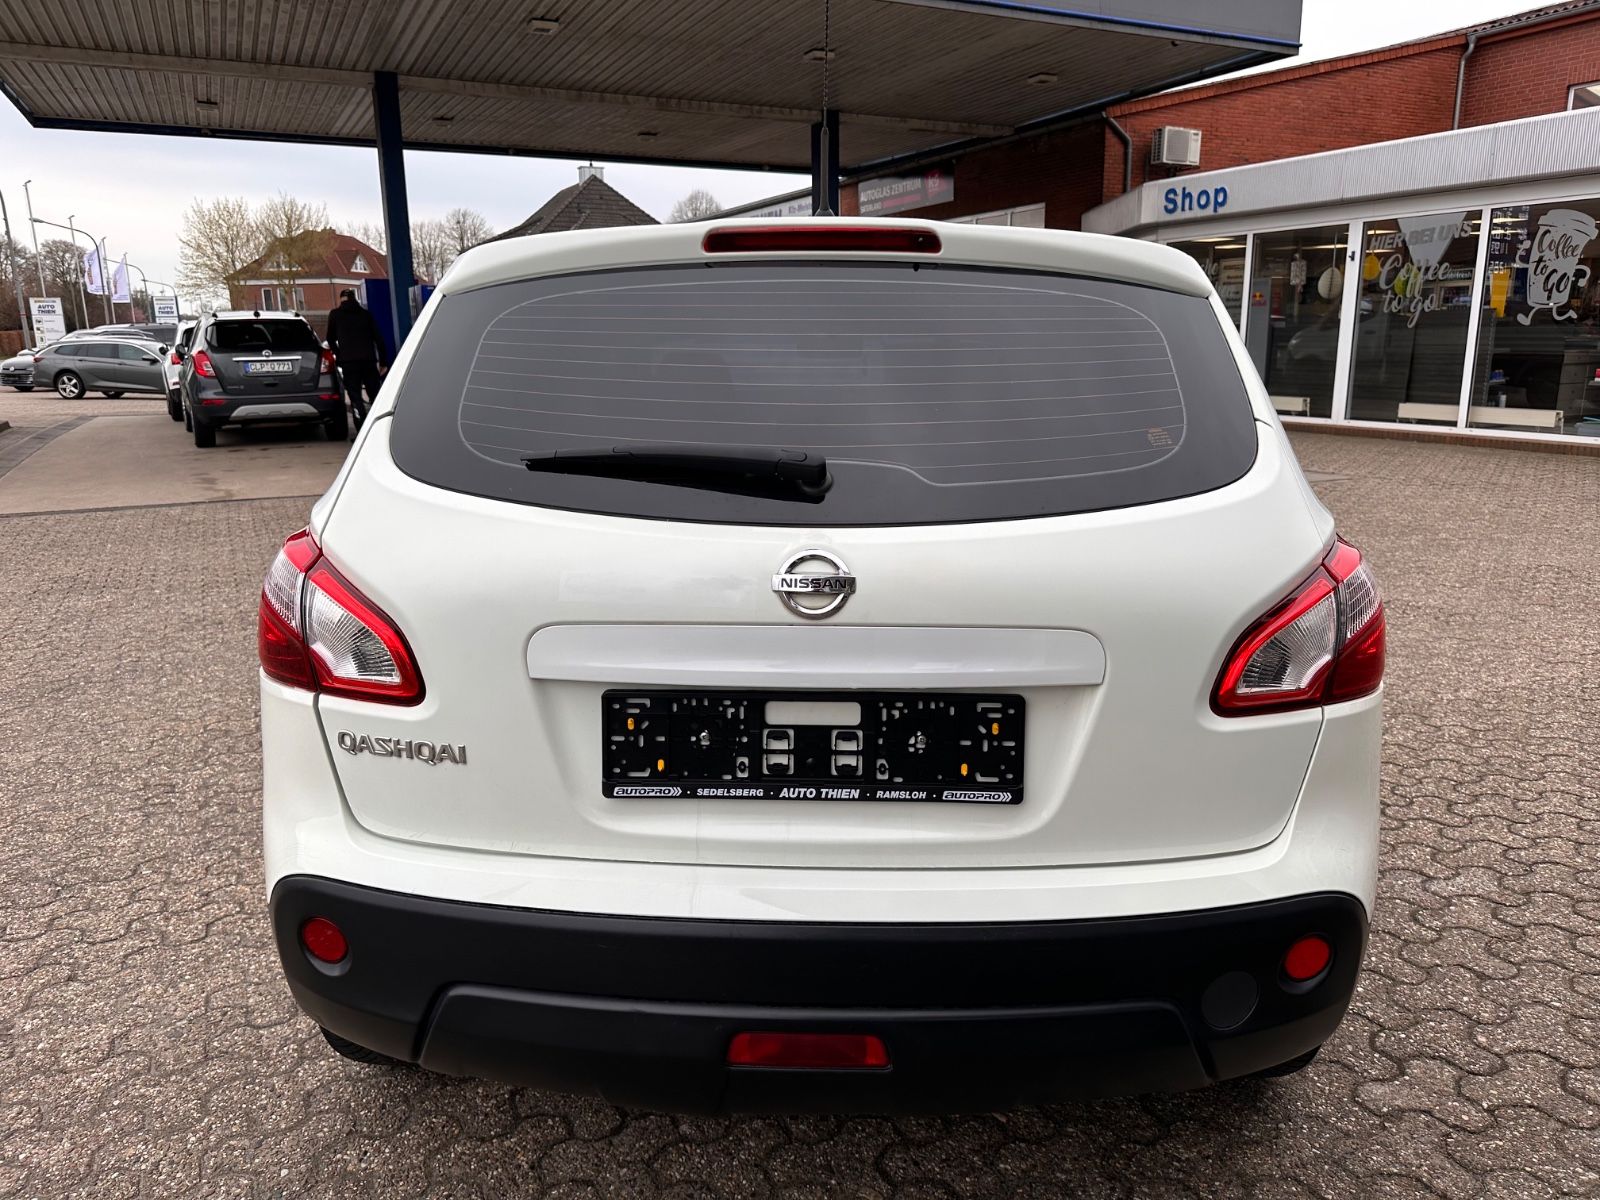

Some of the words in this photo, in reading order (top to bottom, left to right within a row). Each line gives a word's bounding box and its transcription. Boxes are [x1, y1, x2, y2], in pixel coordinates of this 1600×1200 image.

[861, 184, 891, 203] AUTOGLAS
[891, 177, 921, 196] ZENTRUM
[1163, 186, 1228, 214] Shop
[1369, 232, 1405, 250] HIER
[1437, 220, 1473, 239] UNS
[1537, 228, 1580, 260] Coffee
[1379, 254, 1450, 298] Coffee
[1531, 256, 1549, 277] to
[1383, 289, 1403, 313] to
[1407, 294, 1438, 328] go
[781, 578, 847, 589] NISSAN
[337, 729, 468, 766] QASHQAI
[697, 788, 764, 797] SEDELSBERG
[779, 788, 816, 798] AUTO
[820, 788, 860, 799] THIEN
[876, 790, 927, 799] RAMSLOH
